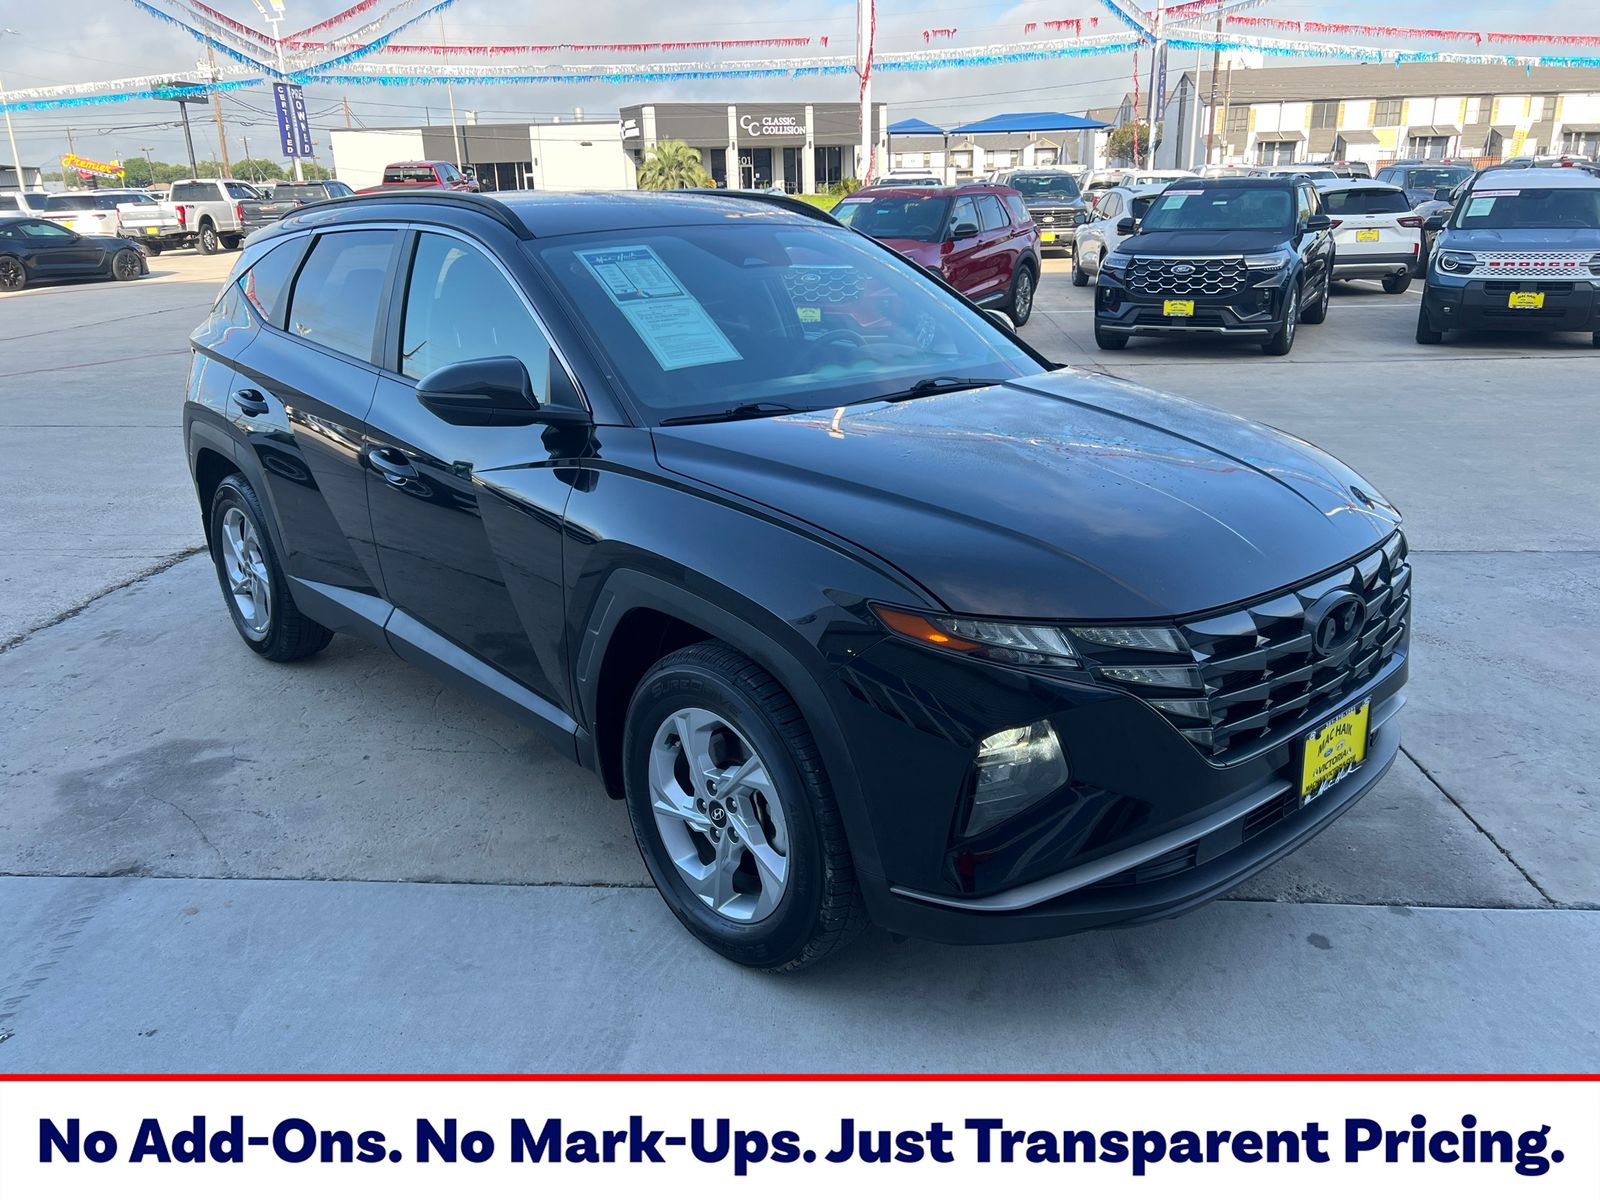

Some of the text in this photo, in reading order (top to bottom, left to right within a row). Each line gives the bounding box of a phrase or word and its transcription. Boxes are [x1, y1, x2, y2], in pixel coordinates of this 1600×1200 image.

[277, 86, 294, 154] CERTIFIED
[295, 100, 310, 153] OWNED
[762, 117, 796, 126] CLASSIC
[762, 126, 806, 135] COLLISION
[62, 153, 112, 174] Premier
[1317, 728, 1335, 757] MAC
